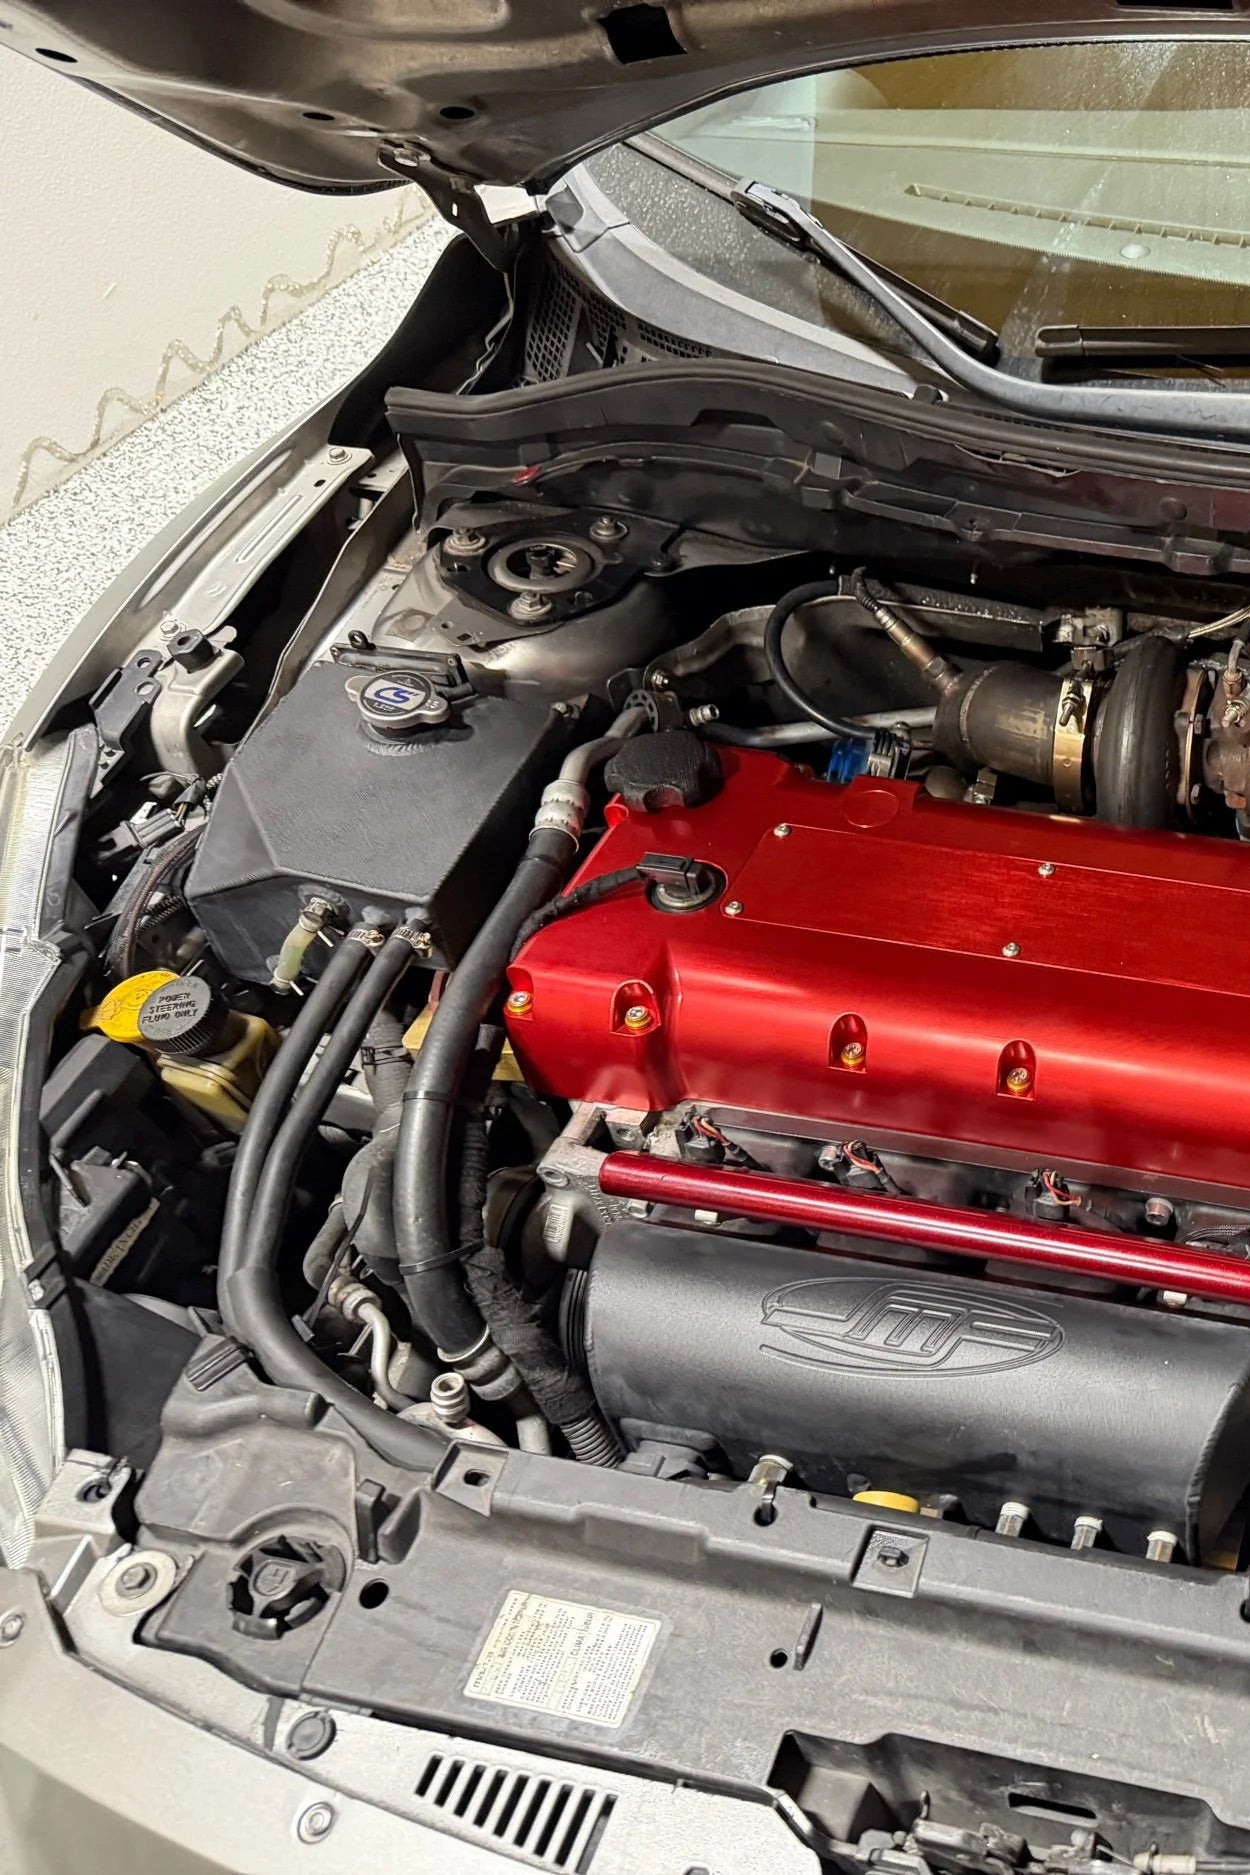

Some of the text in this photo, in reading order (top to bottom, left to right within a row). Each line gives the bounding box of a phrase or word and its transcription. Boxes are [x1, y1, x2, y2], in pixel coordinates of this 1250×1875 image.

[148, 1000, 196, 1014] STEERING
[141, 1008, 198, 1025] FLUID ONLY
